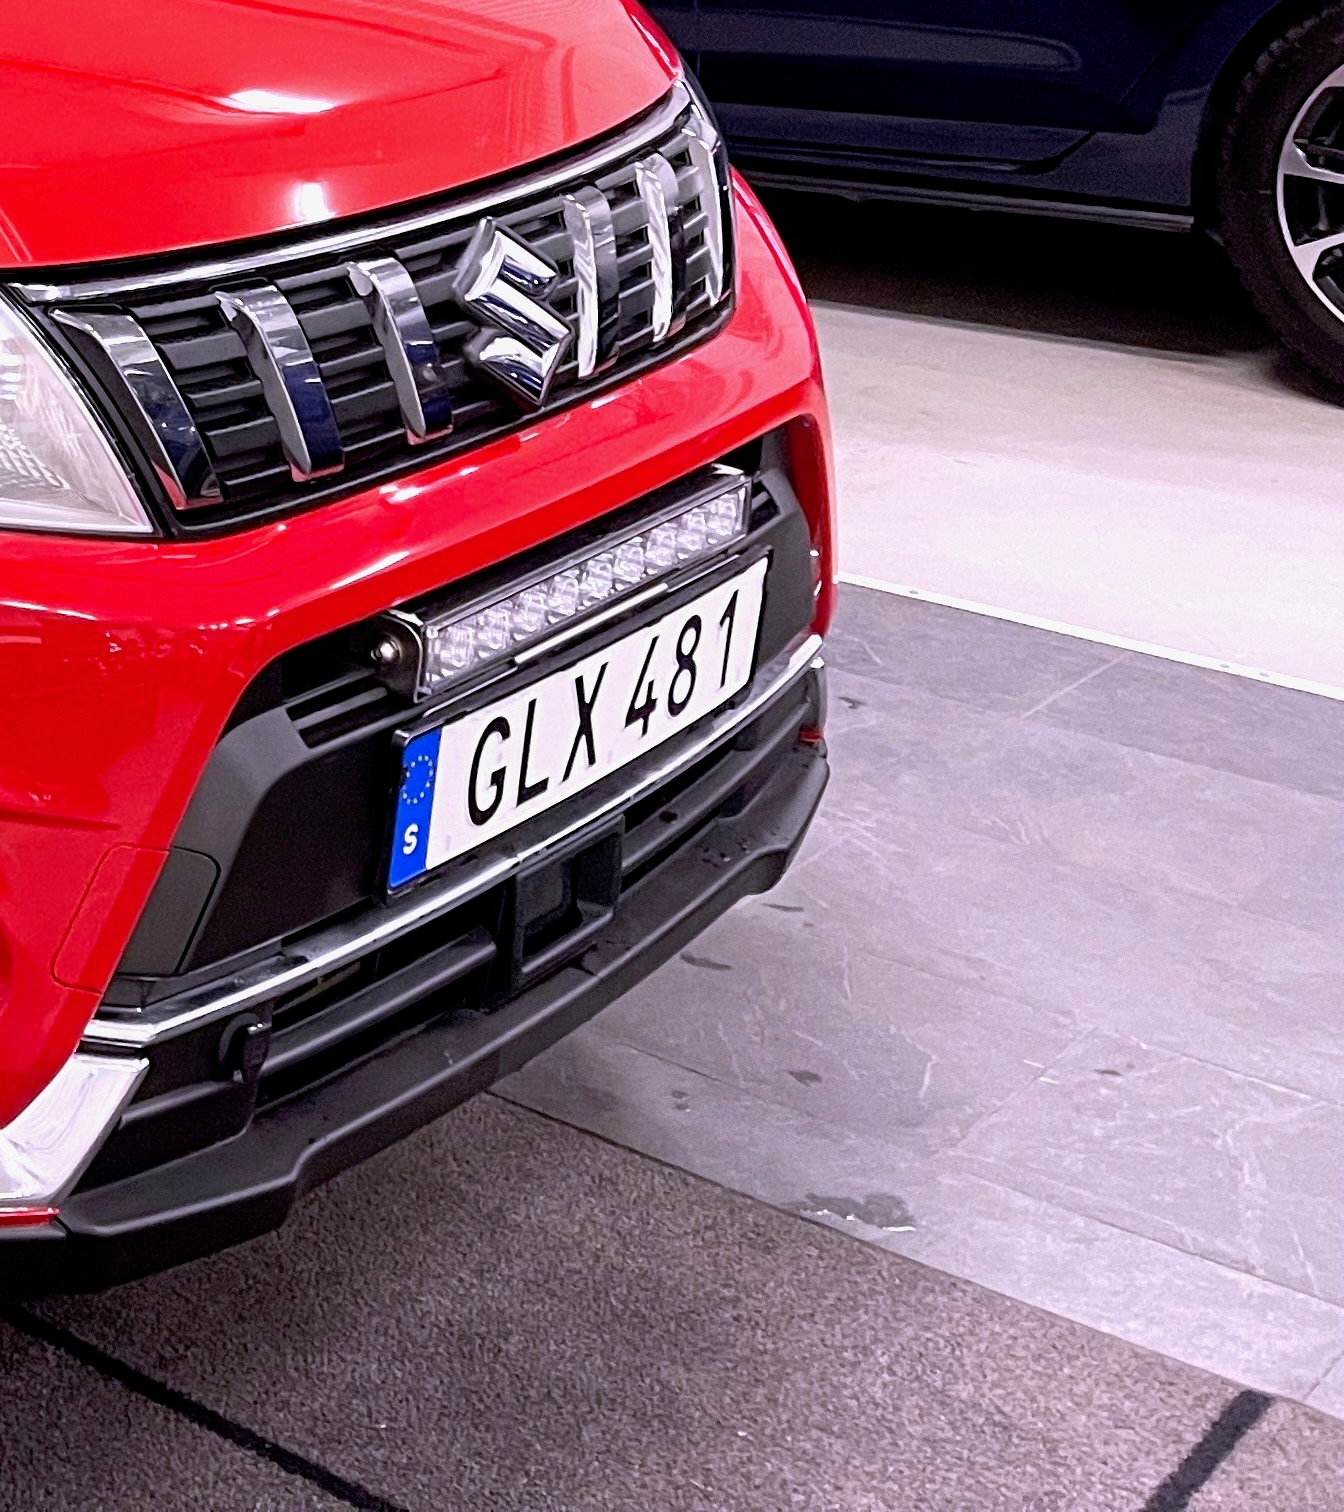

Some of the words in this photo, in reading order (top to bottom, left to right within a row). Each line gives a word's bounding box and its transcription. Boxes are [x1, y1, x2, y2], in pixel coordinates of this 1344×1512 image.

[466, 660, 610, 828] GLX
[623, 587, 742, 740] 481
[401, 823, 419, 856] S
